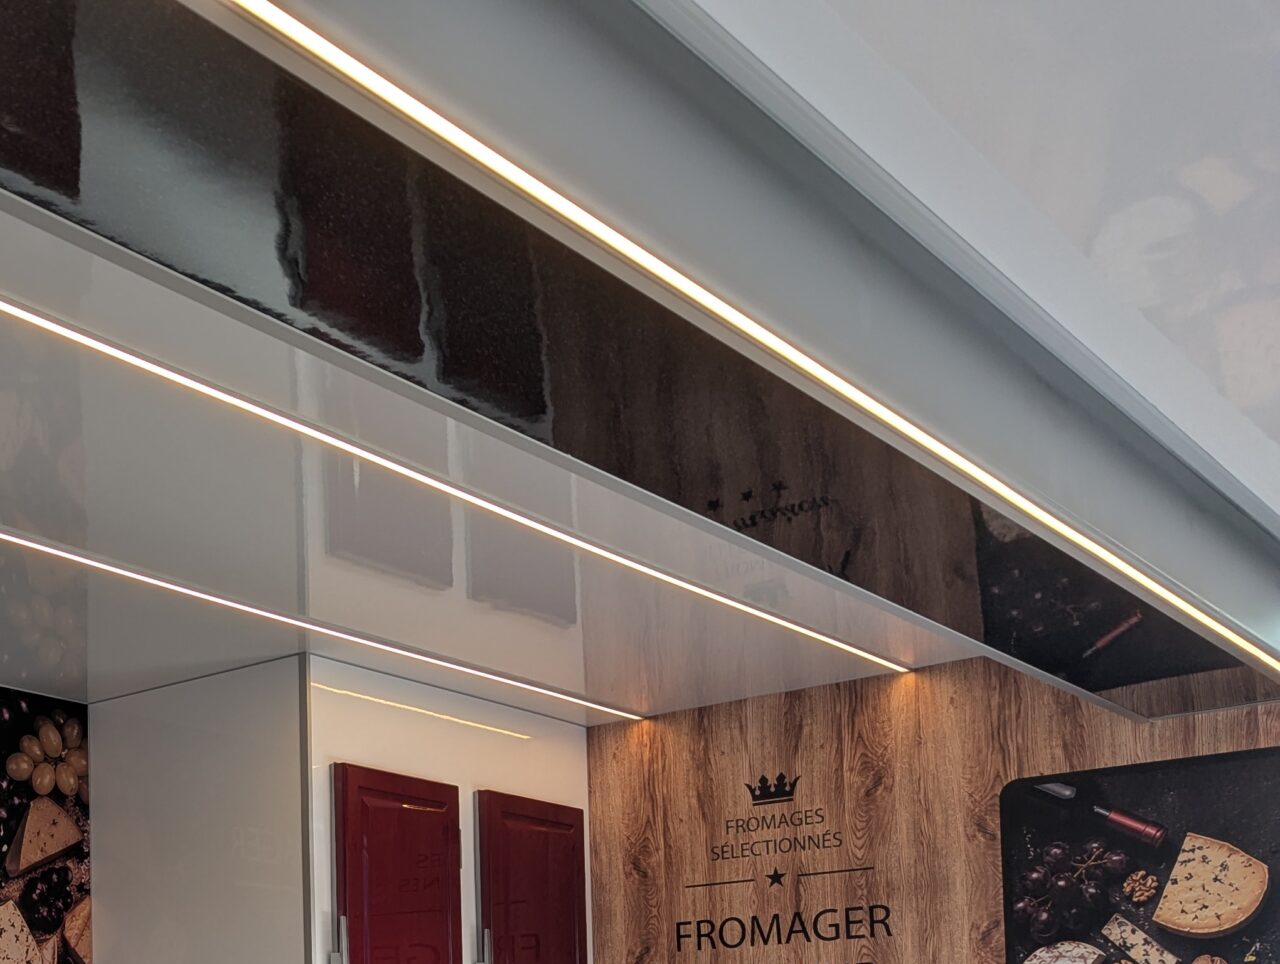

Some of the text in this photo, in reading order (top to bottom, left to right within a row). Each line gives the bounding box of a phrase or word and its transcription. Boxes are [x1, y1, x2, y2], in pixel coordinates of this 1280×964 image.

[725, 808, 825, 836] FROMAGES
[710, 829, 843, 861] SÉLECTIONNÉS
[675, 904, 893, 953] FROMAGER
